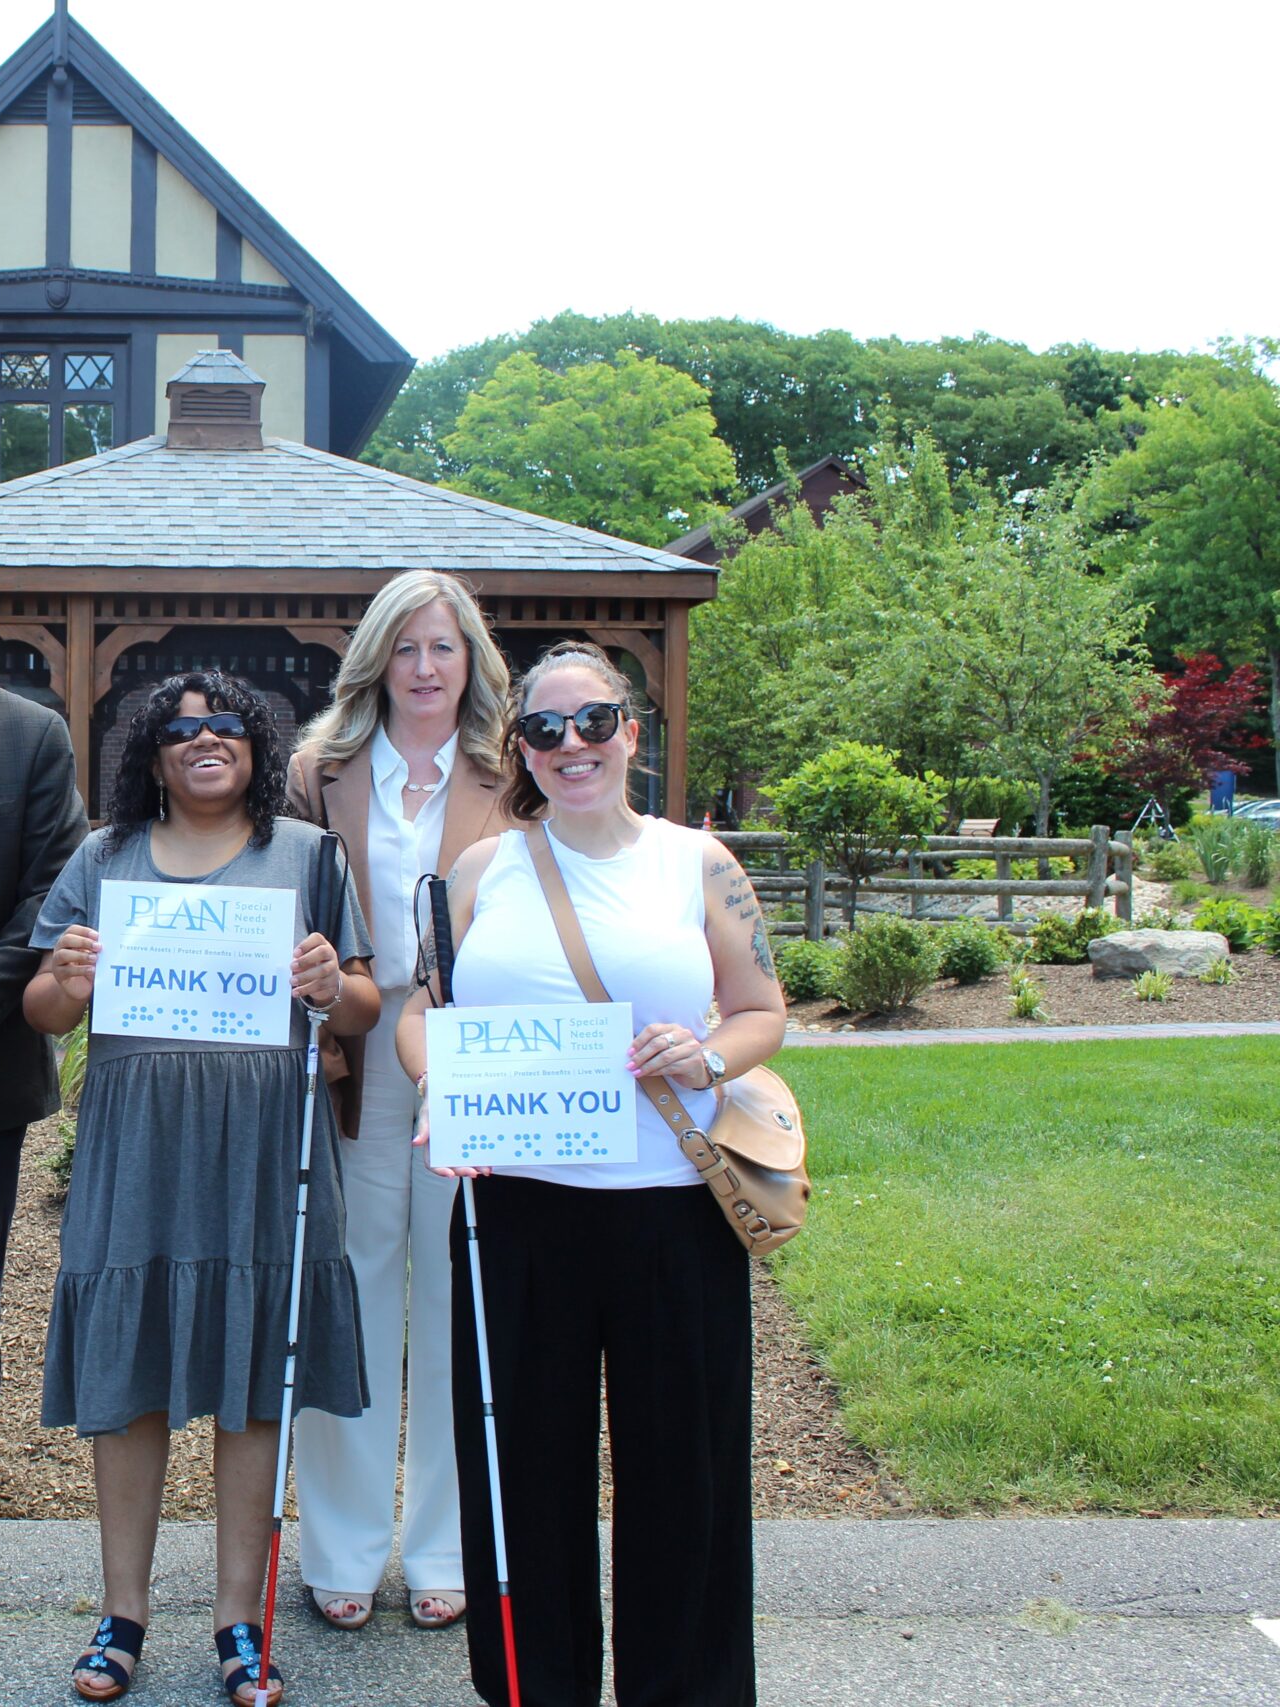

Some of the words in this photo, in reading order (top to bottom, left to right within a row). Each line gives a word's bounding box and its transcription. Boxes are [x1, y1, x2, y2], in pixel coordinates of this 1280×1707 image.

[125, 894, 233, 932] PLAN
[236, 902, 272, 912] Special
[235, 914, 266, 923] Needs
[235, 925, 265, 934] Trusts
[177, 948, 202, 956] Protect
[204, 949, 232, 957] Benefits
[110, 965, 208, 992] THANK
[217, 971, 278, 996] YOU
[456, 1018, 565, 1054] PLAN
[569, 1017, 608, 1027] Special
[570, 1030, 604, 1038] Needs
[571, 1041, 604, 1050] Trusts
[444, 1092, 549, 1117] THANK
[557, 1090, 622, 1114] YOU
